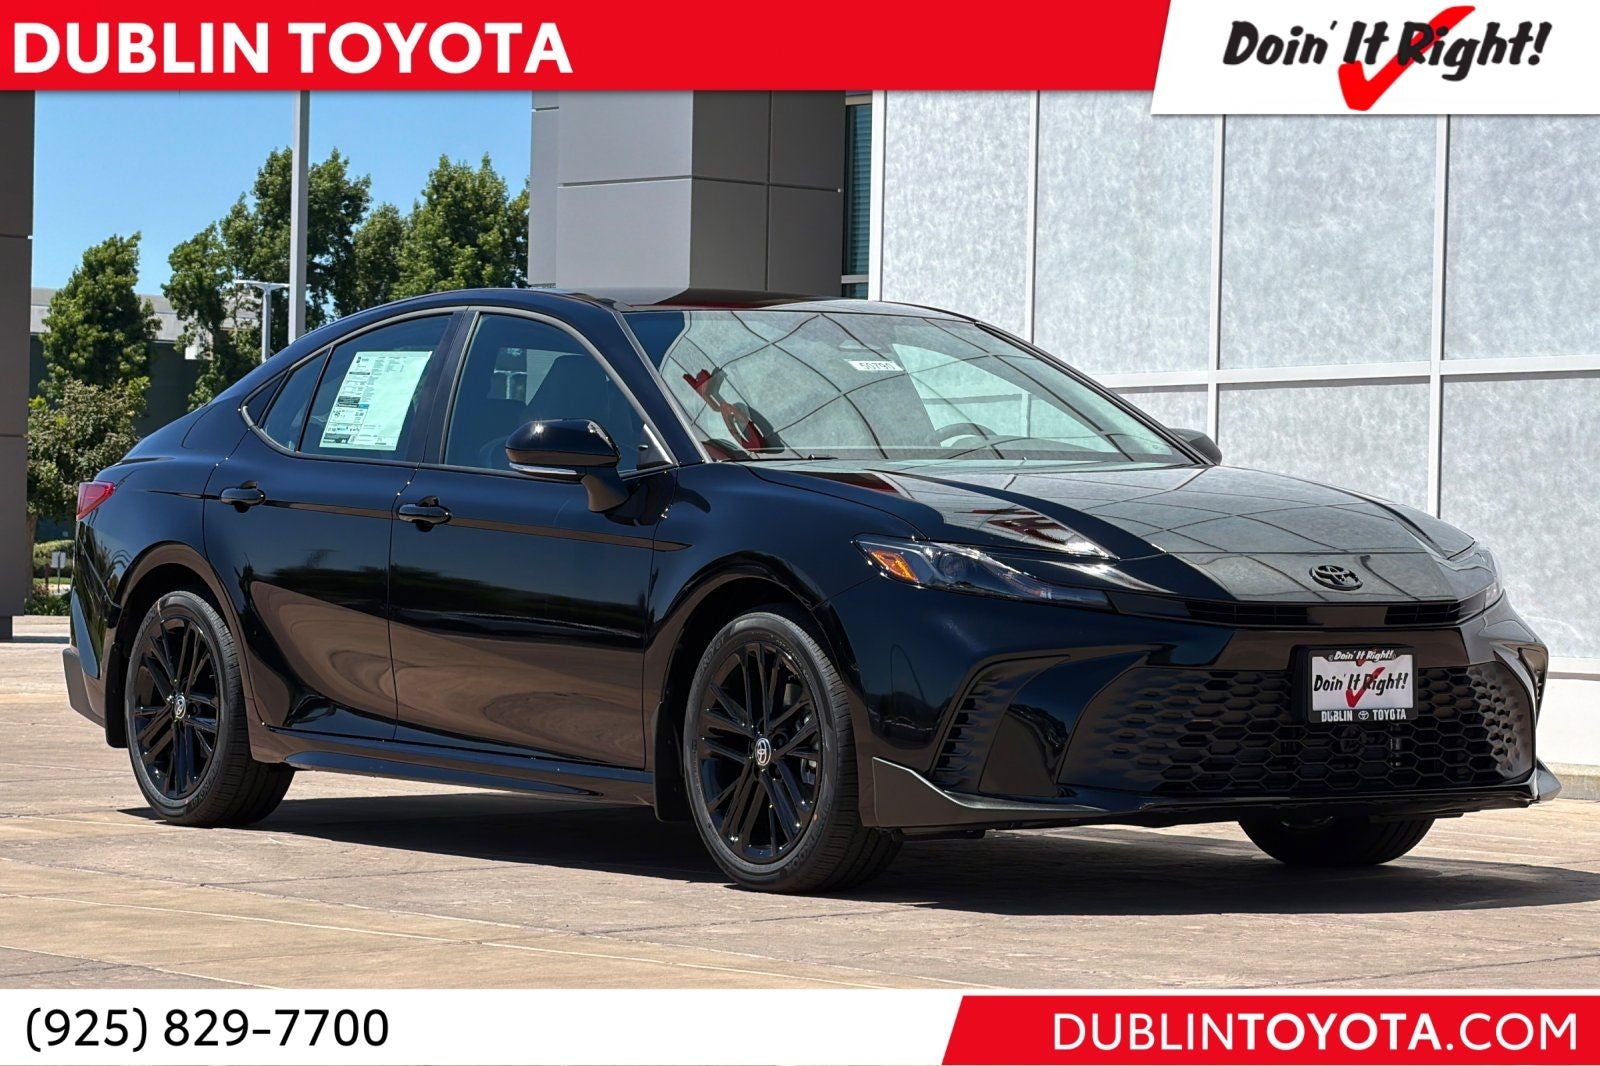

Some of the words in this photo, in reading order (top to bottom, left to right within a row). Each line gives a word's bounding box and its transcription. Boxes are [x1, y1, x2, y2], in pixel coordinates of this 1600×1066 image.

[1334, 650, 1356, 660] Doin'
[1356, 650, 1366, 660] It
[1366, 650, 1394, 662] Right!
[1313, 674, 1346, 692] Doin'
[1347, 673, 1361, 690] It
[1362, 672, 1408, 696] Right!
[1321, 710, 1353, 722] DUBLIN
[1373, 708, 1407, 720] TOYOTA
